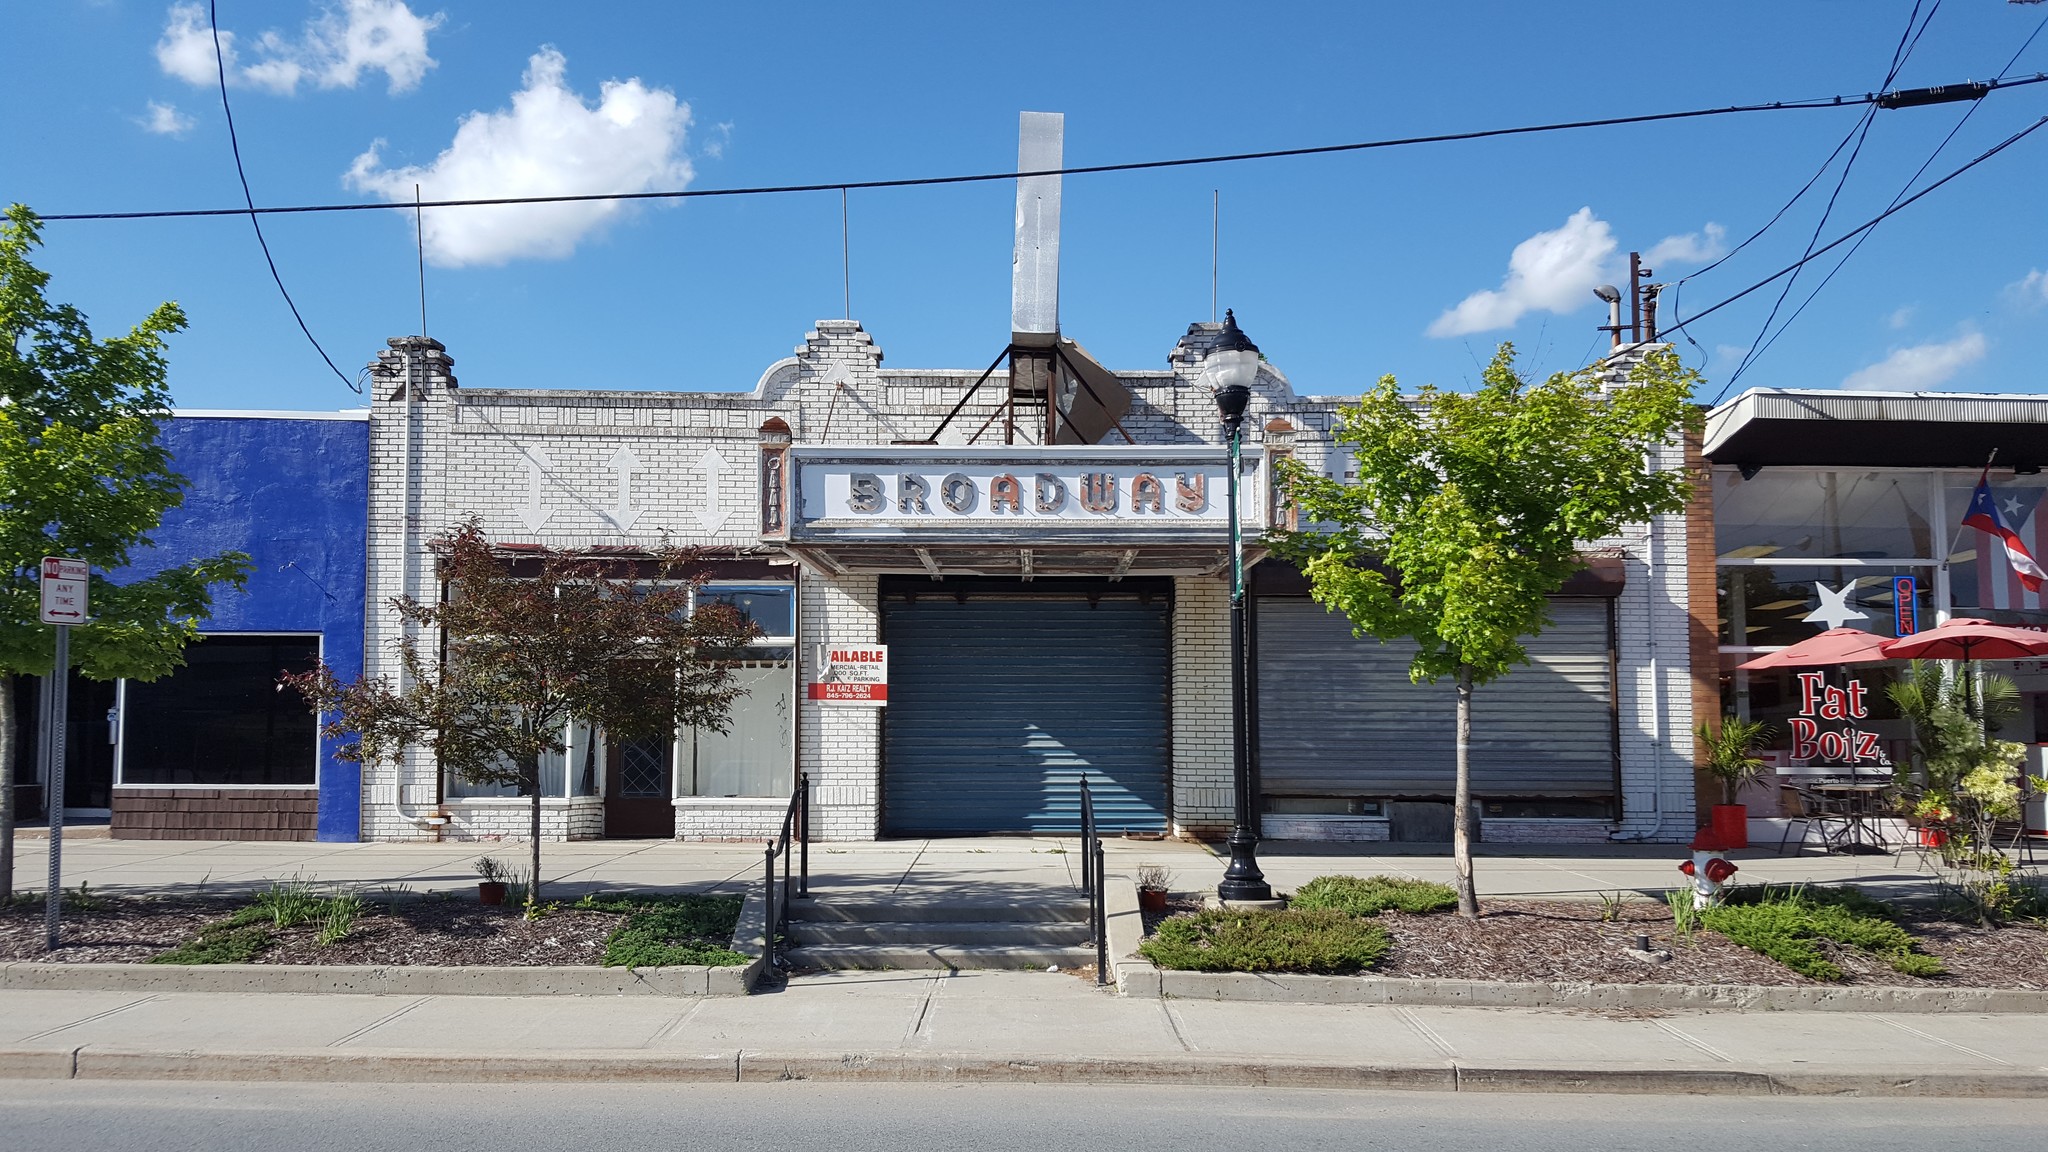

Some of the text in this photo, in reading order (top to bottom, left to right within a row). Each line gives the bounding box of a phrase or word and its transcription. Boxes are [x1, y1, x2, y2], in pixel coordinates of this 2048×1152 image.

[849, 472, 1205, 513] BROADWAY
[45, 562, 86, 575] NO PARKING
[56, 584, 73, 593] ANY
[55, 596, 74, 606] TIME
[1898, 580, 1913, 634] OPEN
[1797, 671, 1868, 720] Fat
[1788, 718, 1881, 763] Boiz
